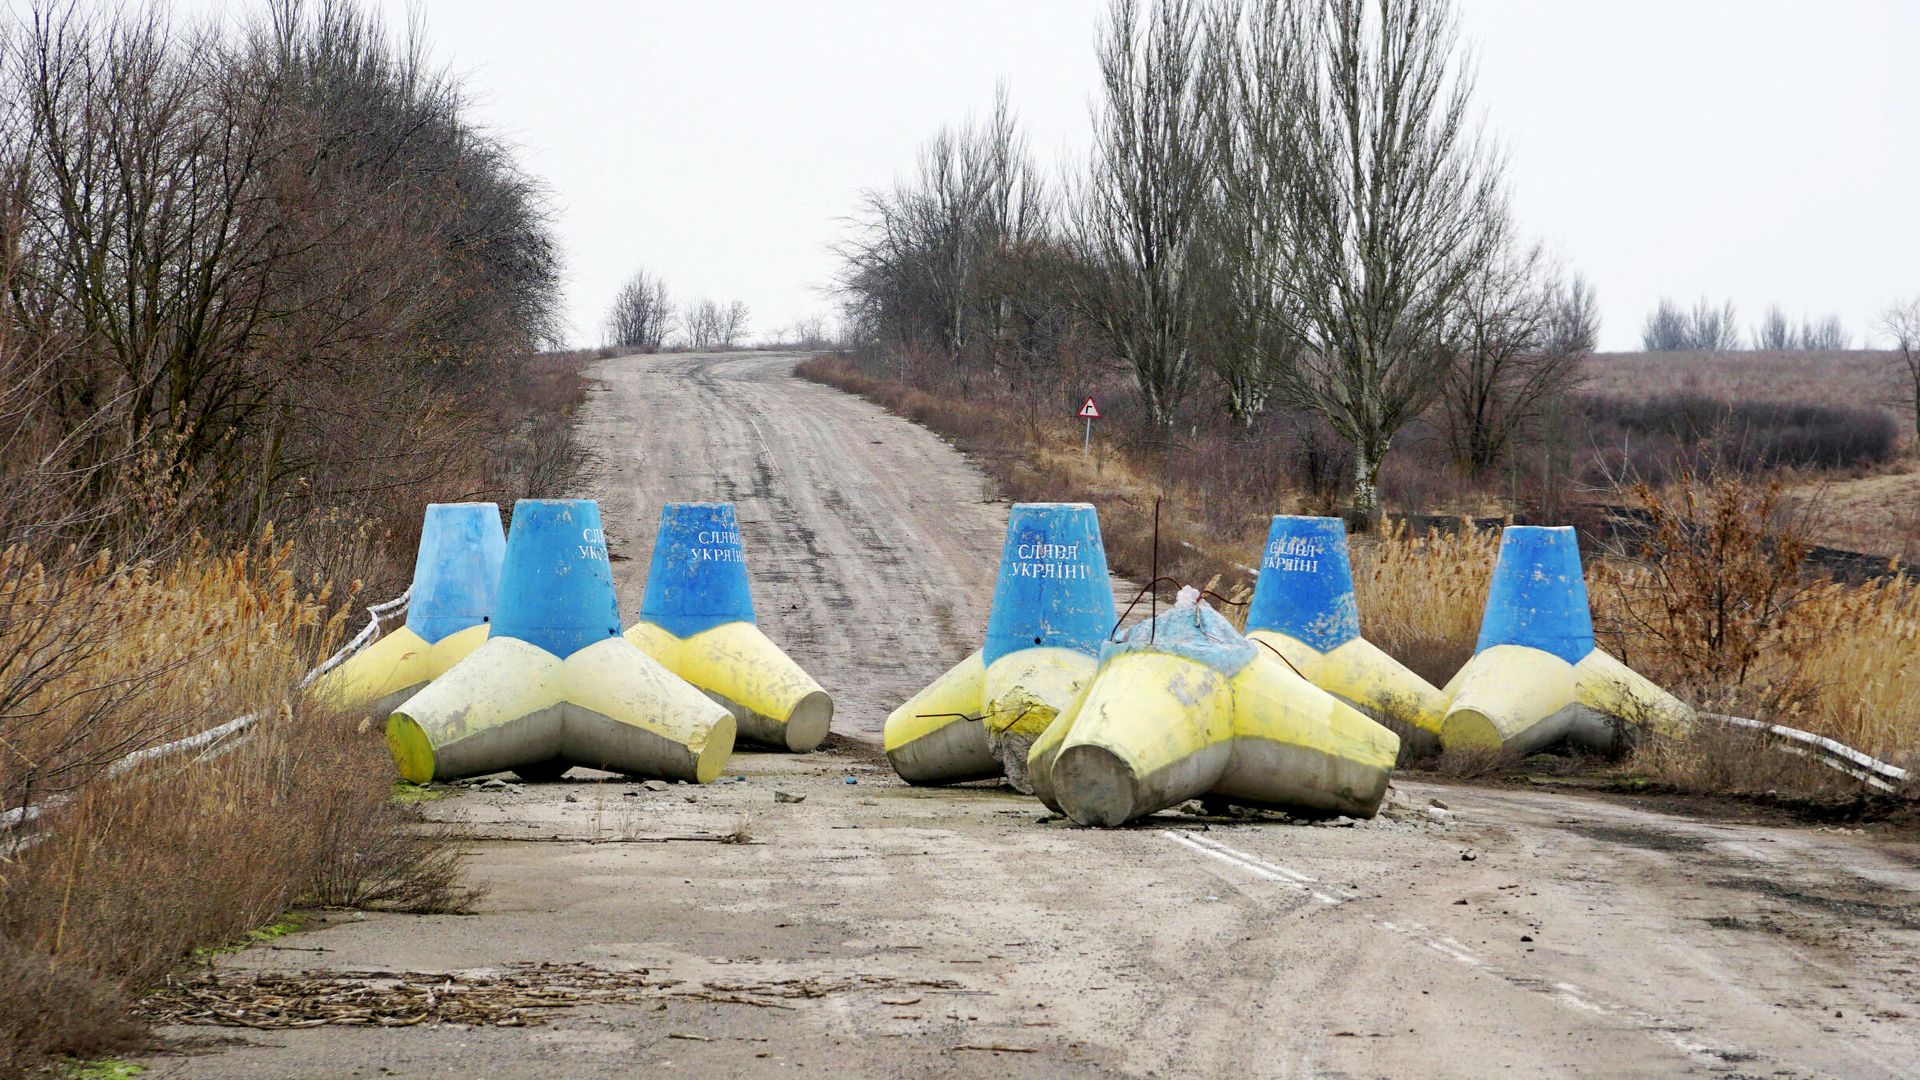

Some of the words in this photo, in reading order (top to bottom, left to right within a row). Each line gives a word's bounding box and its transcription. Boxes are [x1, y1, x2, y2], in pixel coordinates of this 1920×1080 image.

[1018, 543, 1078, 560] СЛАВА
[1011, 562, 1086, 579] УКРАЇНІ
[1263, 556, 1318, 573] УКРАЇНІ
